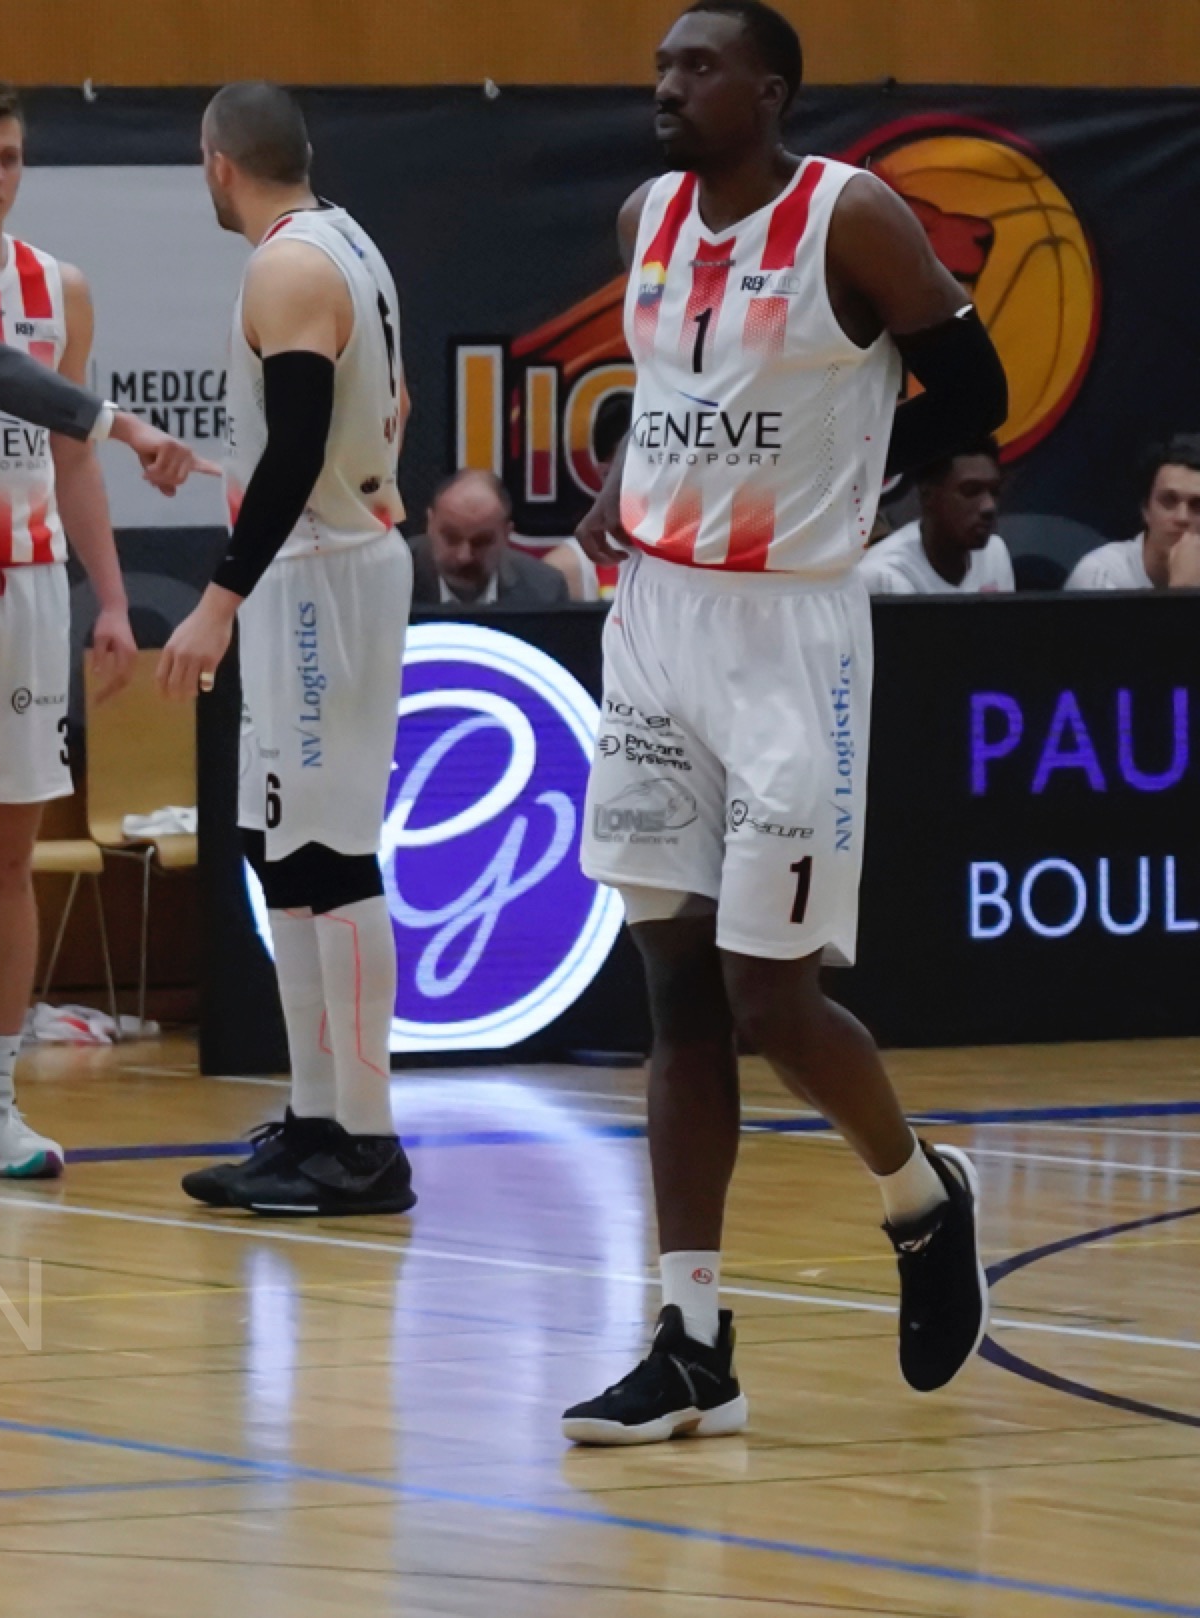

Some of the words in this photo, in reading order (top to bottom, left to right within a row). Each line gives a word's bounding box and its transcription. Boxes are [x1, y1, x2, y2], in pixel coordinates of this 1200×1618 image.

[692, 307, 713, 374] 1
[294, 600, 327, 721] Logistics
[789, 855, 813, 925] 1
[969, 854, 1200, 940] BOUL
